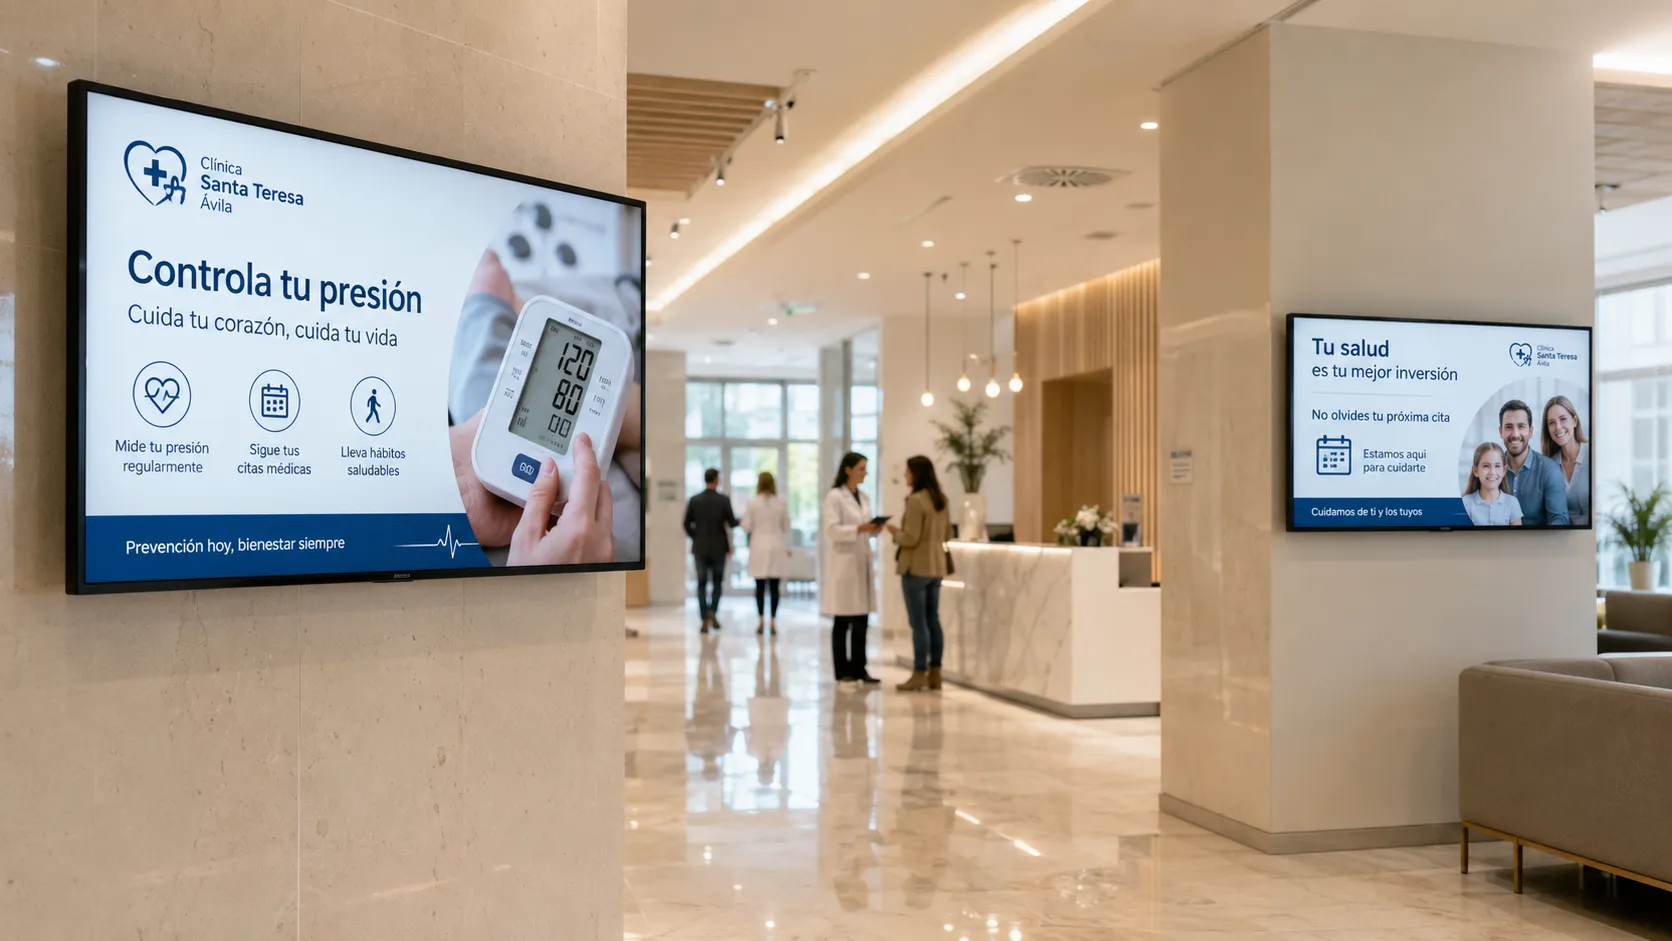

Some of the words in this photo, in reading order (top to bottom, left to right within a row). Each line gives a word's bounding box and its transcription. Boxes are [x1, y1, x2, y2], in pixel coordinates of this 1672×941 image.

[200, 156, 242, 176] Clínica
[201, 174, 248, 197] Santa
[252, 183, 304, 206] Teresa
[200, 193, 232, 213] Ávila
[128, 250, 271, 297] Controla
[280, 270, 310, 301] tu
[320, 279, 421, 314] presión
[128, 304, 184, 328] Cuida
[189, 311, 208, 330] tu
[214, 316, 289, 340] corazón,
[295, 322, 340, 342] cuida
[344, 326, 361, 344] tu
[365, 328, 398, 347] vida
[1312, 338, 1334, 356] Tu
[1340, 339, 1389, 357] salud
[1556, 352, 1578, 360] Teresa
[558, 342, 594, 381] 120
[1312, 366, 1328, 377] es
[1332, 364, 1347, 378] tu
[1351, 364, 1392, 382] mejor
[1396, 365, 1458, 381] inversión
[552, 378, 583, 415] 80
[1312, 409, 1328, 420] No
[1331, 409, 1370, 421] olvides
[1372, 411, 1383, 421] tu
[1386, 411, 1429, 424] próxima
[1431, 412, 1450, 423] cita
[115, 439, 146, 453] Mide
[149, 441, 162, 453] tu
[166, 441, 209, 456] presión
[250, 443, 280, 459] Sigue
[283, 445, 300, 456] tus
[341, 446, 367, 458] Lleva
[370, 447, 406, 459] hábitos
[1363, 448, 1404, 459] Estamos
[123, 460, 203, 476] regularmente
[237, 461, 263, 474] citas
[267, 462, 312, 475] médicas
[347, 464, 400, 476] saludables
[1363, 464, 1385, 474] para
[1387, 462, 1426, 473] cuidarte
[1311, 507, 1355, 516] Cuidamos
[1357, 507, 1369, 516] de
[1370, 507, 1376, 516] ti
[1378, 509, 1384, 518] y
[1385, 507, 1398, 516] los
[1399, 508, 1423, 518] tuyos
[126, 538, 203, 554] Prevención
[207, 538, 234, 555] hoy,
[238, 537, 296, 552] bienestar
[298, 537, 345, 552] siempre
